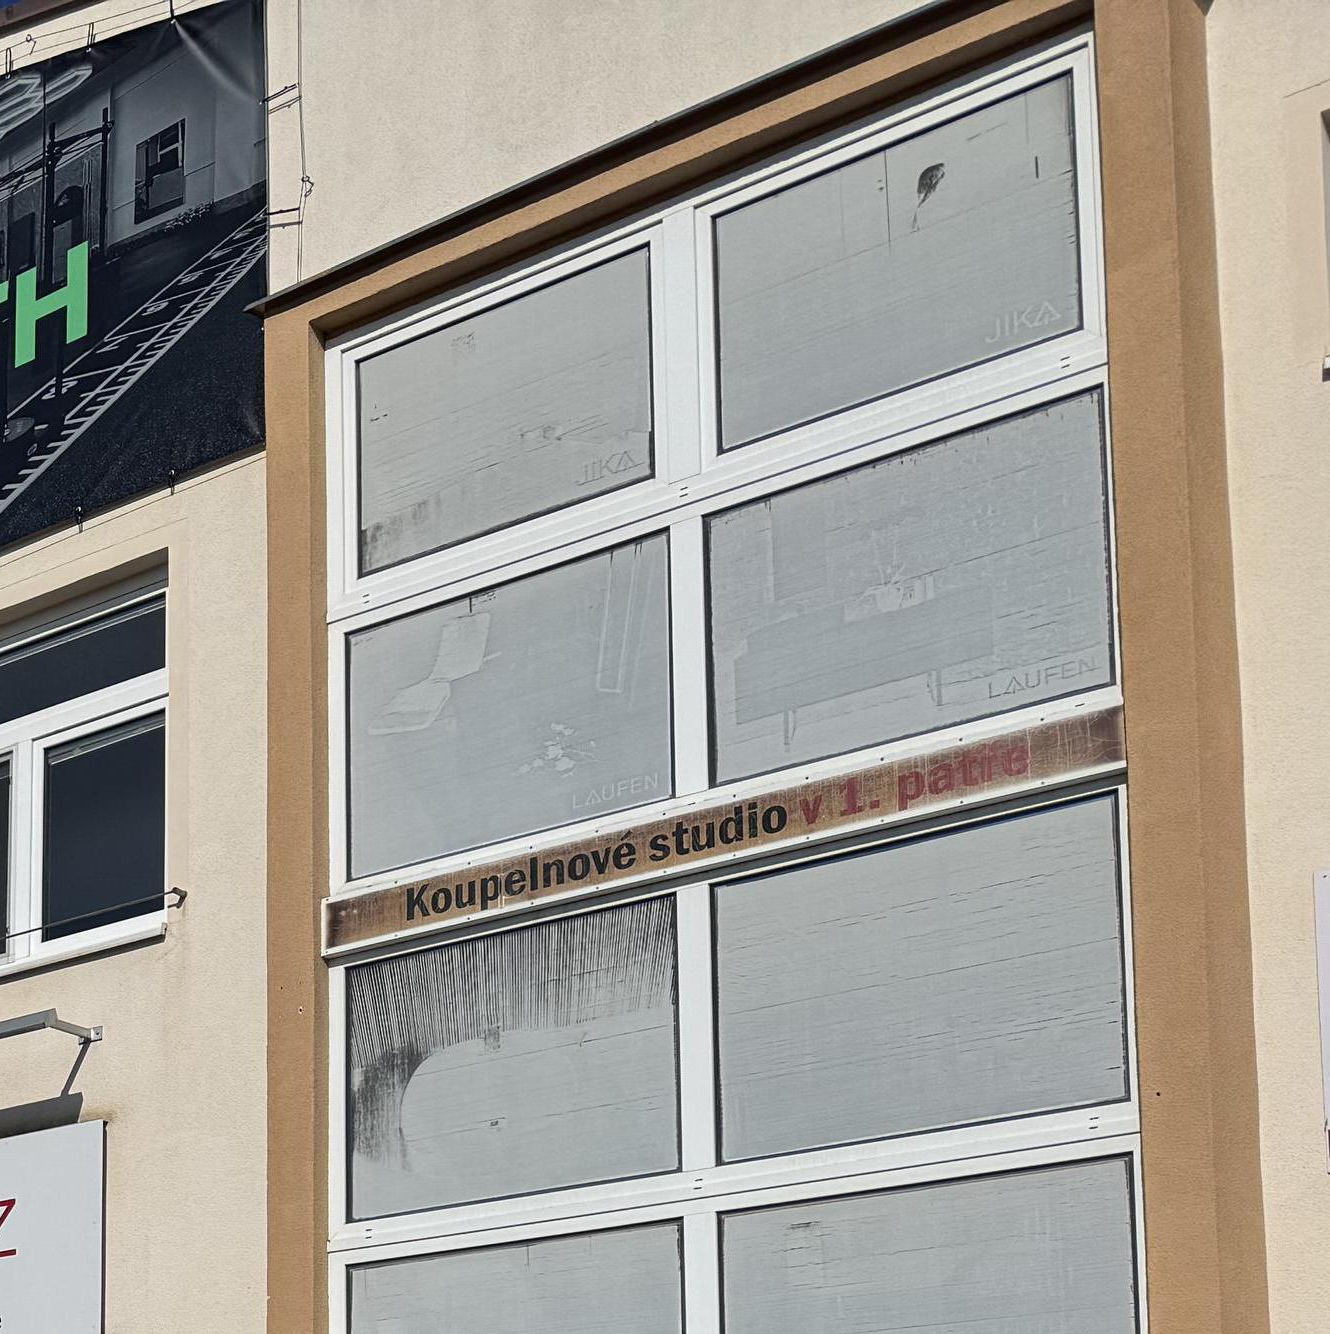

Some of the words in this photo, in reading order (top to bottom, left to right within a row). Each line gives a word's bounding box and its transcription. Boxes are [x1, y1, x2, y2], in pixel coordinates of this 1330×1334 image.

[984, 301, 1061, 343] JIKA
[988, 656, 1099, 698] LAUFEN
[572, 772, 658, 809] LAUFEN
[406, 830, 636, 921] Koupelnové
[649, 801, 787, 861] studio
[800, 795, 822, 825] v
[840, 777, 880, 816] 1.
